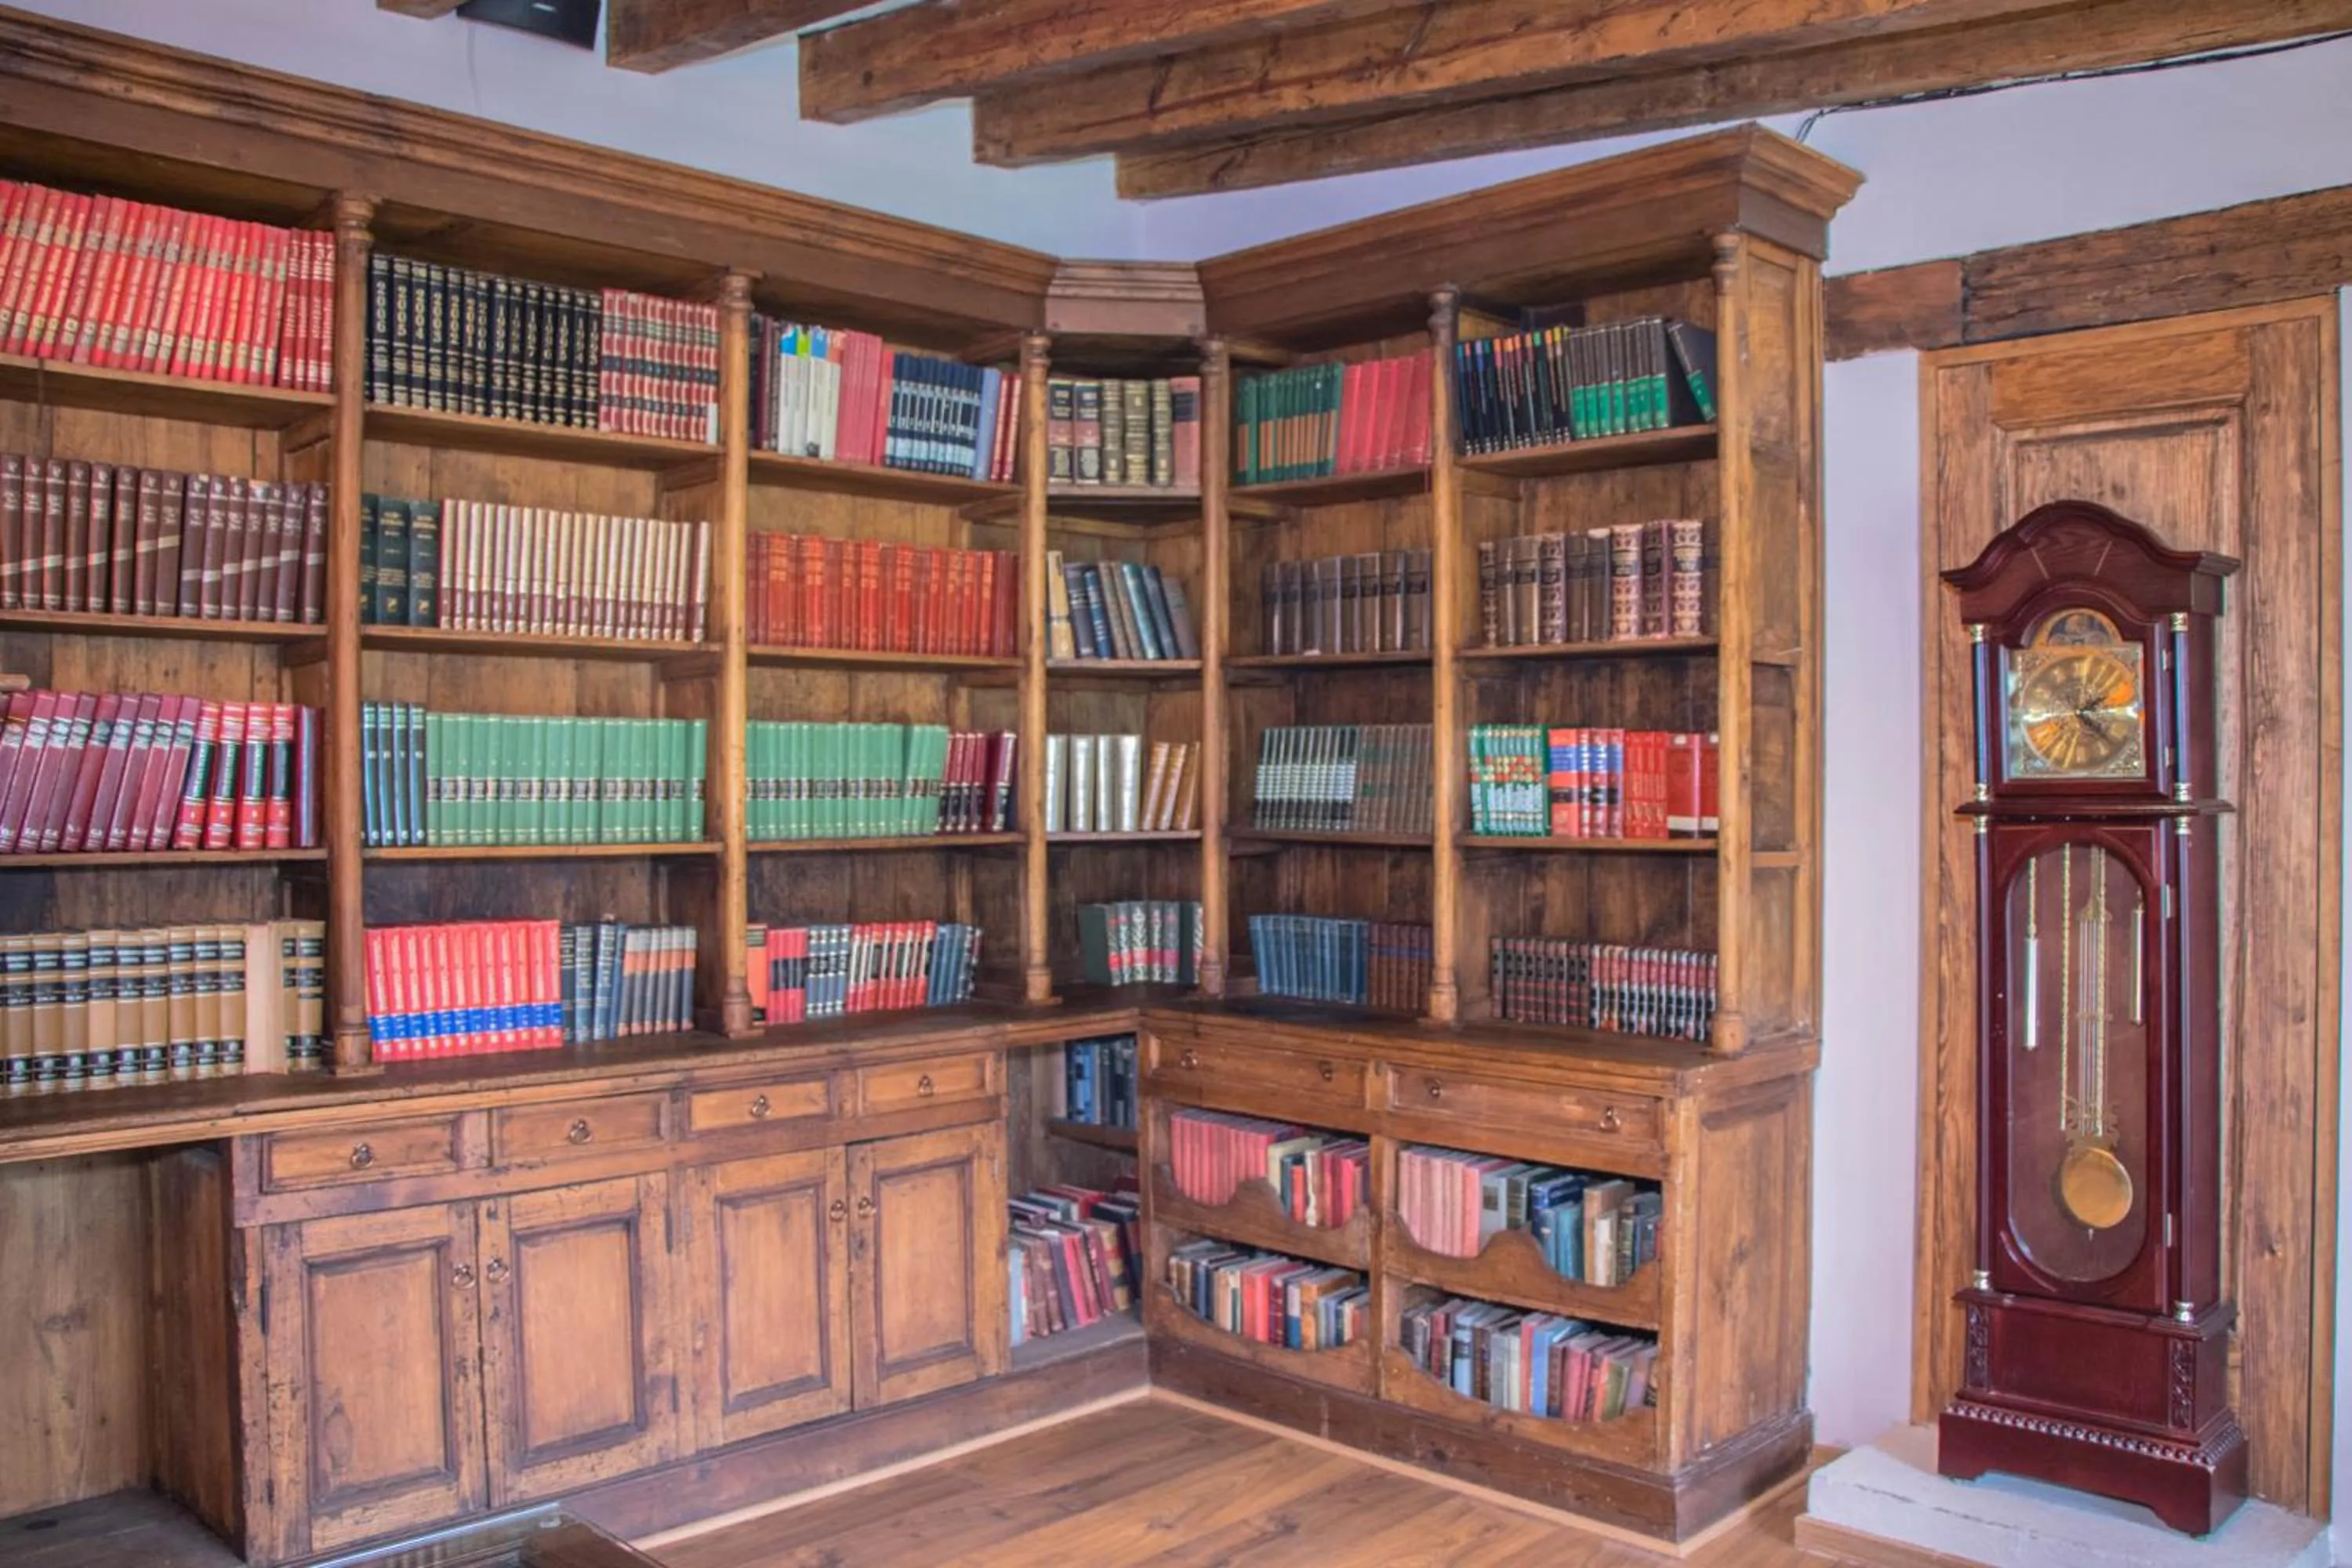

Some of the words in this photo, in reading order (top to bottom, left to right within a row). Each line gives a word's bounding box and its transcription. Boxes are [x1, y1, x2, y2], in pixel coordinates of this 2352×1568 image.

[376, 281, 386, 332] 2006
[397, 285, 407, 336] 2005
[415, 289, 425, 339] 2004
[433, 292, 442, 343] 2003
[450, 295, 460, 345] 2002
[466, 298, 475, 347] 2001
[477, 302, 487, 351] 2000
[495, 305, 506, 352] 1999
